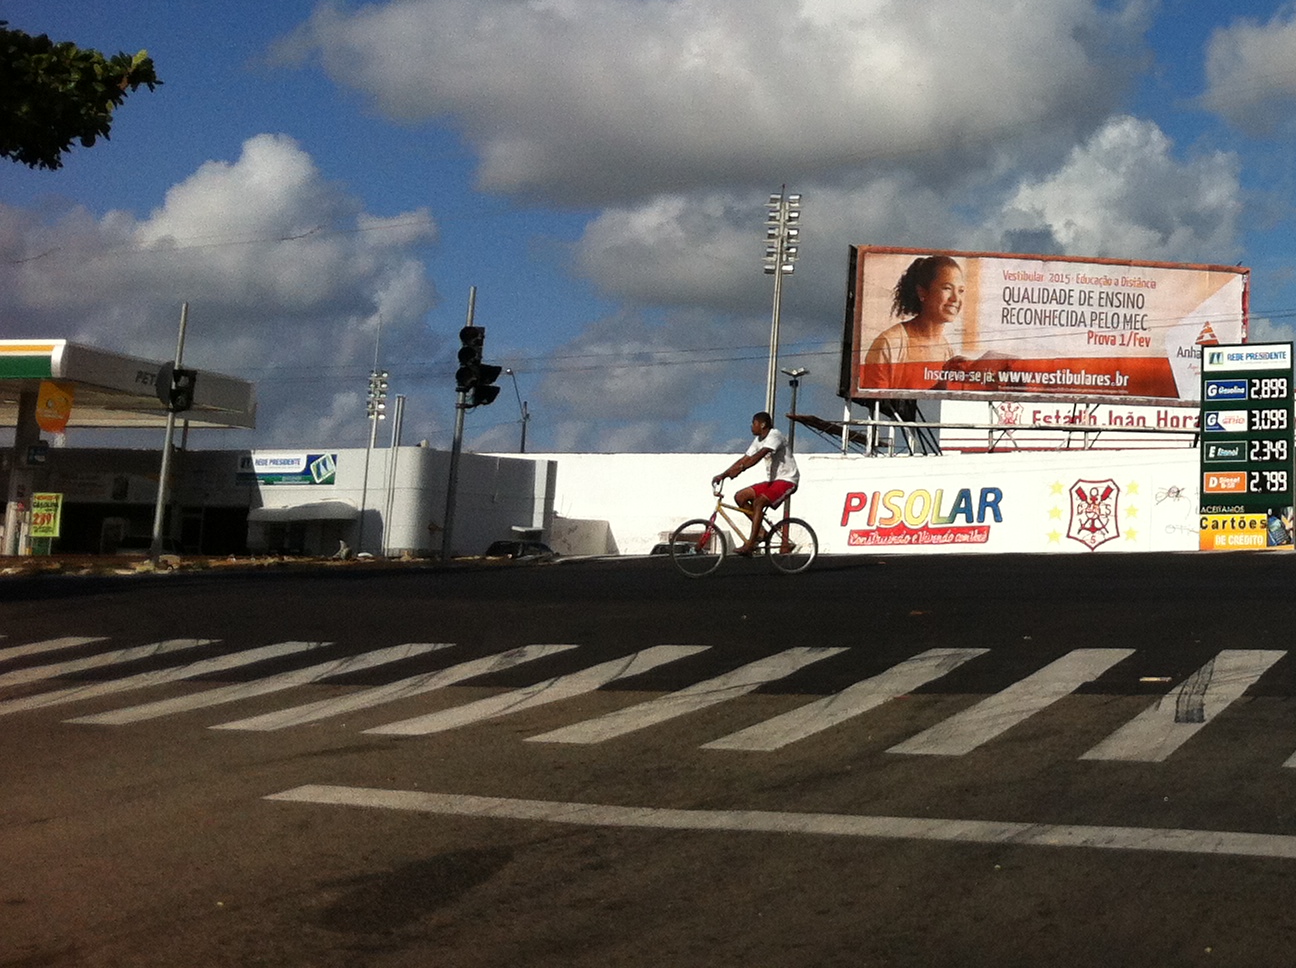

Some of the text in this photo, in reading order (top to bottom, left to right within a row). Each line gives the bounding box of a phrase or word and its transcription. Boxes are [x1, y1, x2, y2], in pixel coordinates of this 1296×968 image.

[1003, 270, 1044, 282] Vestibular
[1050, 273, 1070, 284] 2015
[1076, 273, 1112, 287] Educação
[1002, 286, 1145, 309] QUALIDADE DE ENSINO
[1001, 307, 1087, 327] RECONHECIDA
[1090, 312, 1119, 330] PELO
[1087, 330, 1151, 347] Prova 1/Fev
[1177, 346, 1201, 359] Anha
[1227, 351, 1287, 361] REDE PRESIDENTE
[924, 367, 981, 383] Inscreva-se
[998, 368, 1129, 387] www.vestibulares.br
[1207, 384, 1217, 396] G
[1207, 413, 1217, 426] G
[1209, 446, 1216, 458] E
[1209, 477, 1218, 488] D
[840, 487, 1003, 527] PISOLAR
[1200, 506, 1245, 514] ACEITAMOS
[1200, 516, 1267, 530] Cartões
[1215, 533, 1264, 546] DE CRÉDITO
